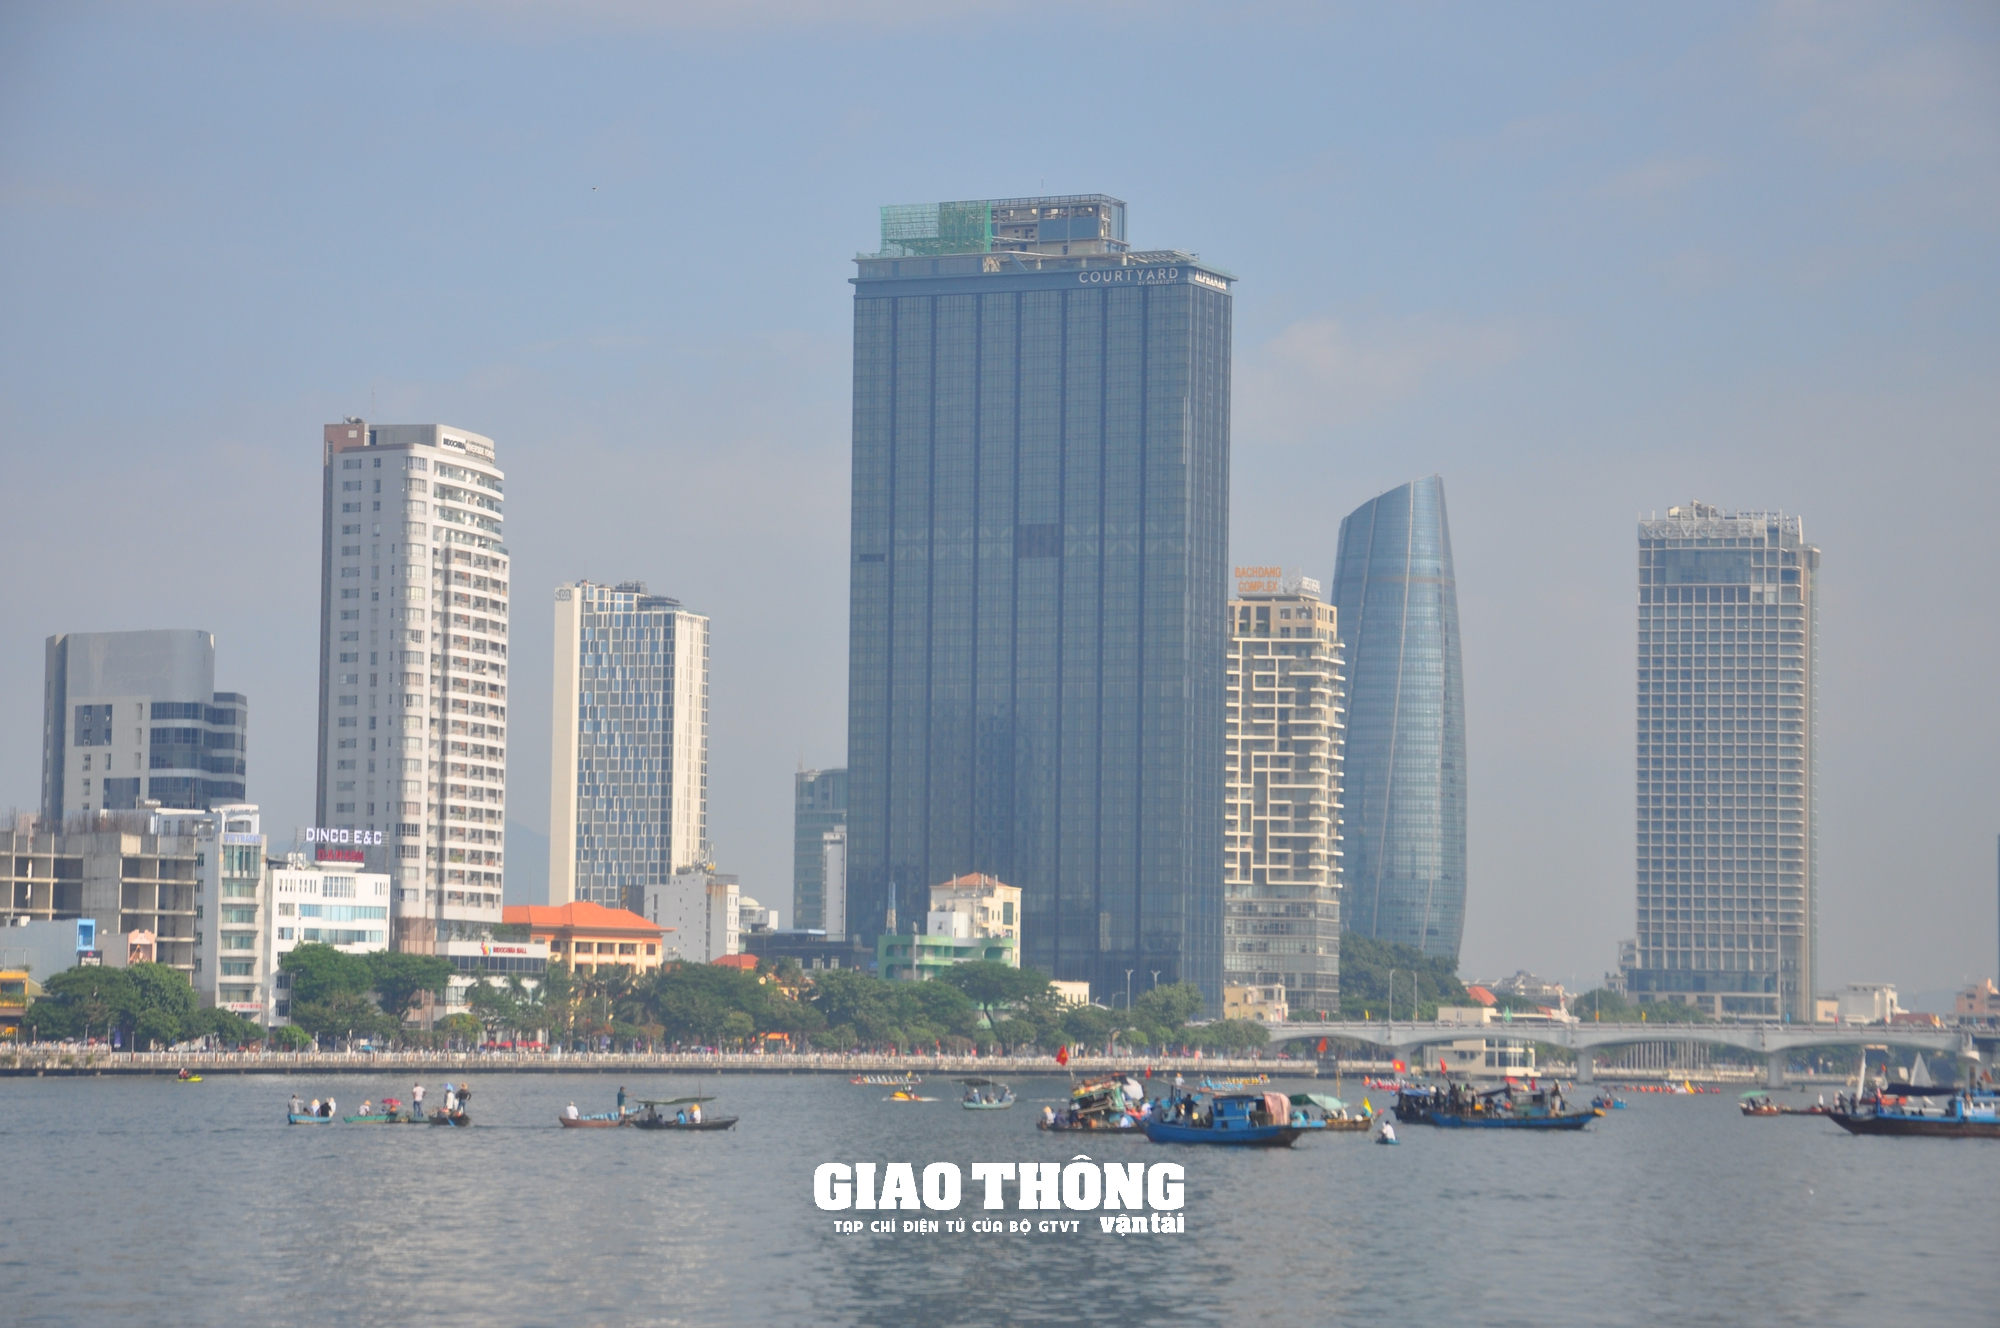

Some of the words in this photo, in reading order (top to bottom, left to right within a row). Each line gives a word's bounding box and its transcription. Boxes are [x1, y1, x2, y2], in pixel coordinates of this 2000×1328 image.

[1079, 268, 1179, 283] COURTYARD
[1639, 520, 1764, 539] NOVOTEL
[1235, 566, 1281, 578] BACHDANG
[1238, 580, 1278, 592] COMPLEX
[306, 827, 349, 843] DINCO
[354, 830, 382, 845] E&C
